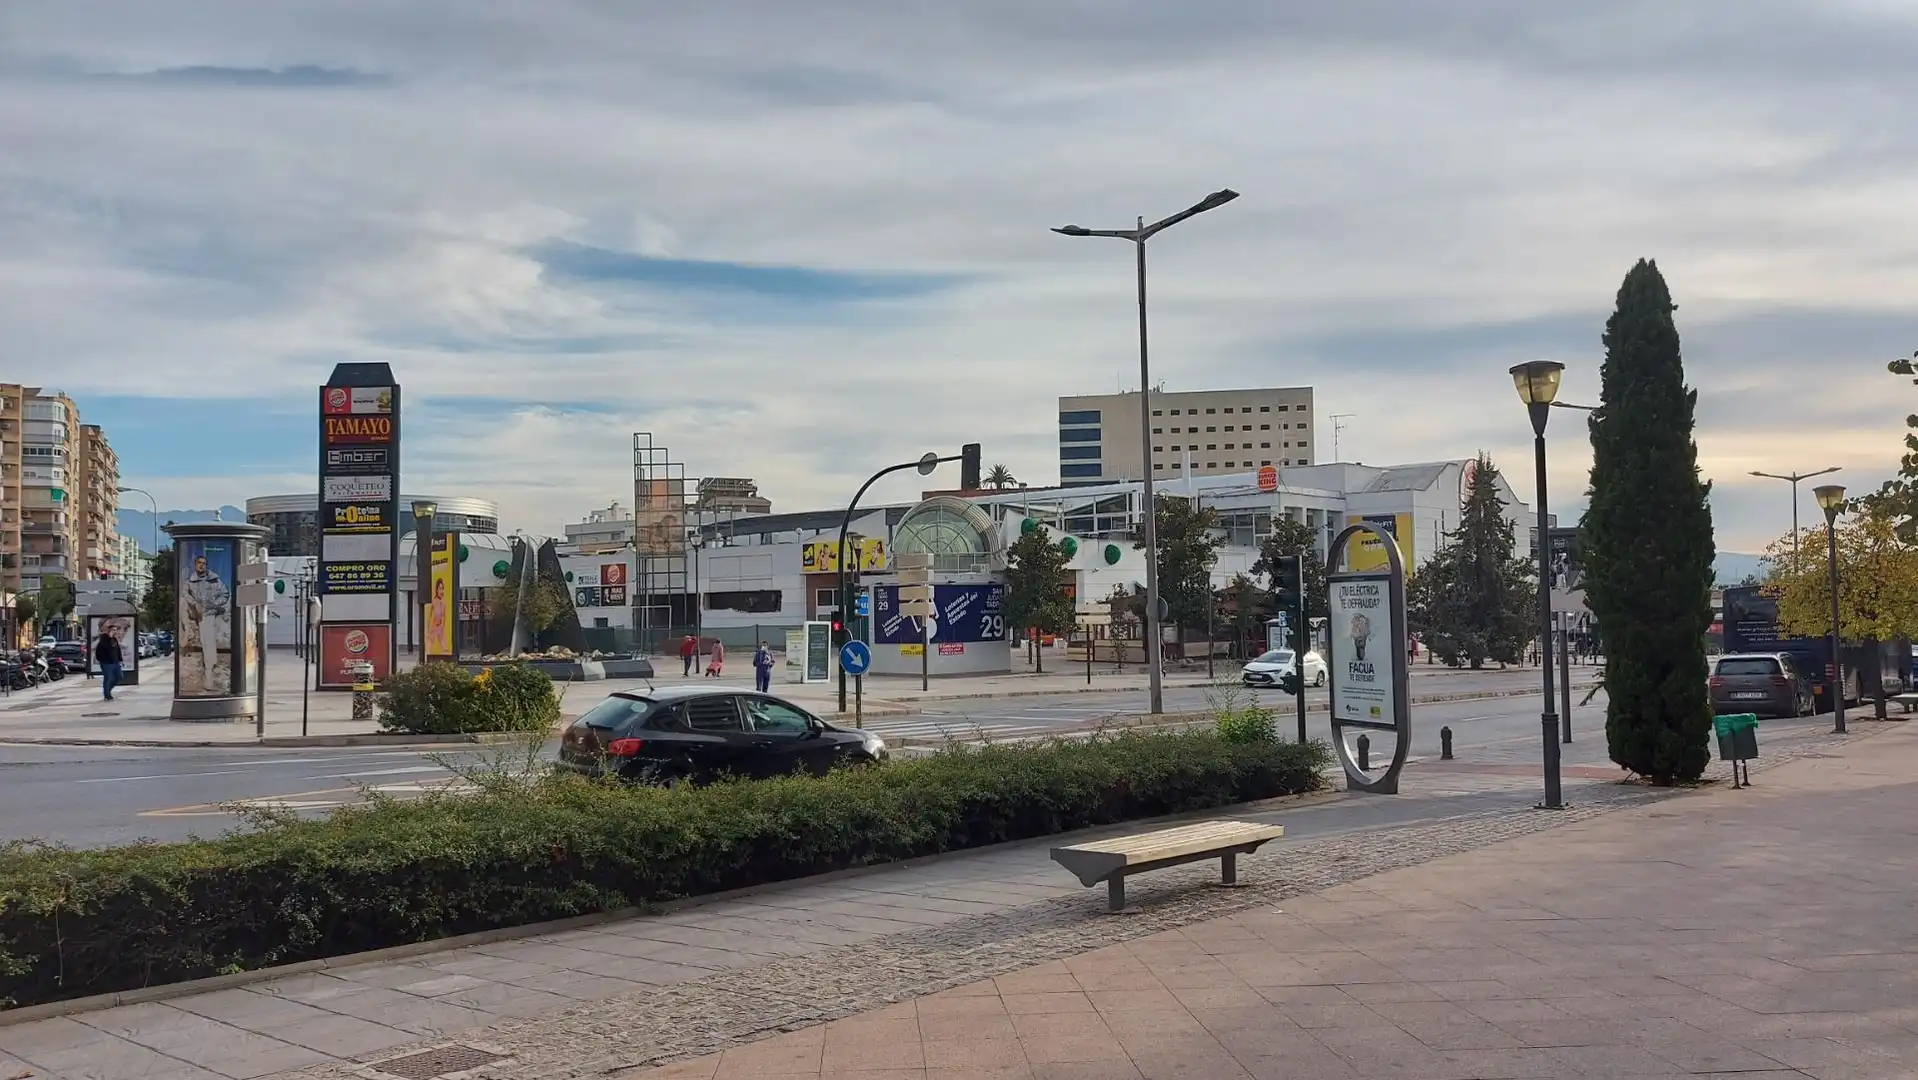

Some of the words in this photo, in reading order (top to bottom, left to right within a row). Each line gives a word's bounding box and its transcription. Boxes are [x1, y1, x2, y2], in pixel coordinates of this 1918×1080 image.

[326, 417, 391, 435] TAMAYO
[879, 601, 889, 611] 29
[982, 615, 1004, 638] 29
[1349, 661, 1375, 675] FACUA
